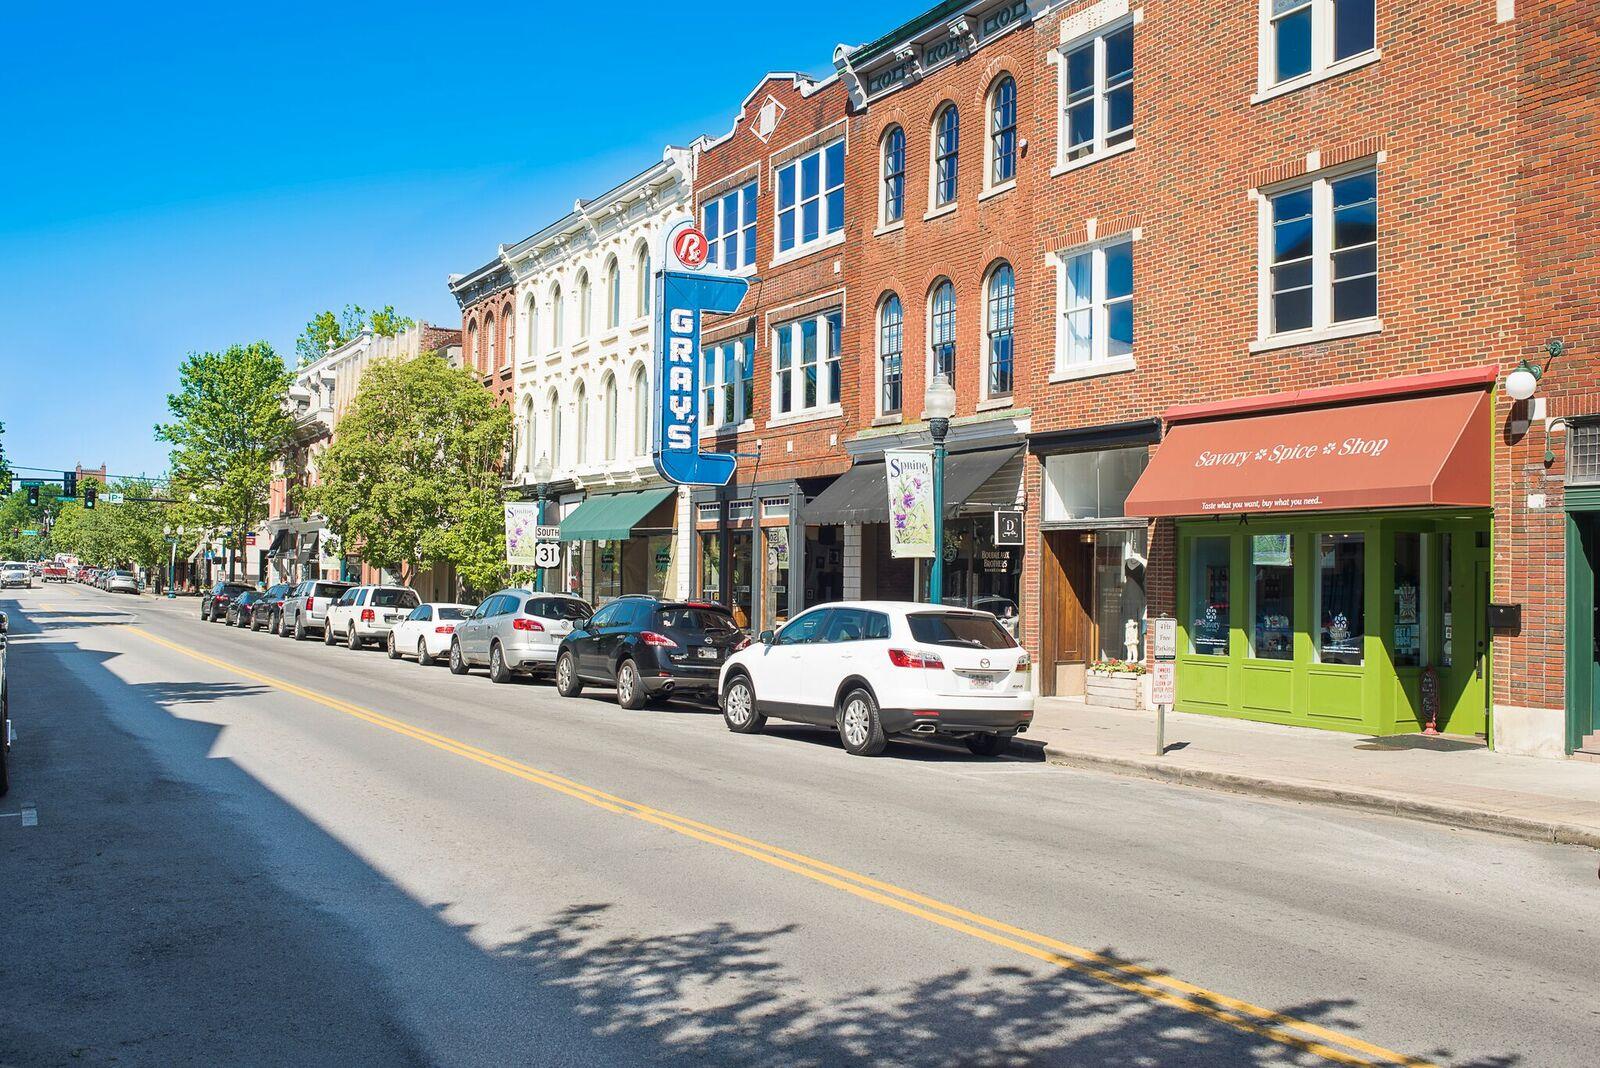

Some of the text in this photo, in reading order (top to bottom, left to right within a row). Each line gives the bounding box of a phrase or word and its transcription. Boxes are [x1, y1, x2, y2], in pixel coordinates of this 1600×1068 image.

[668, 308, 695, 450] GRAY'S
[1195, 437, 1389, 467] Savory Spice Shop
[1201, 502, 1216, 510] Taste
[1217, 501, 1232, 509] what
[1232, 502, 1243, 511] you
[1244, 500, 1261, 509] want,
[1262, 499, 1273, 508] buy
[1274, 498, 1290, 508] what
[1290, 499, 1303, 508] you
[537, 528, 560, 537] SOUTH
[540, 547, 555, 562] 31
